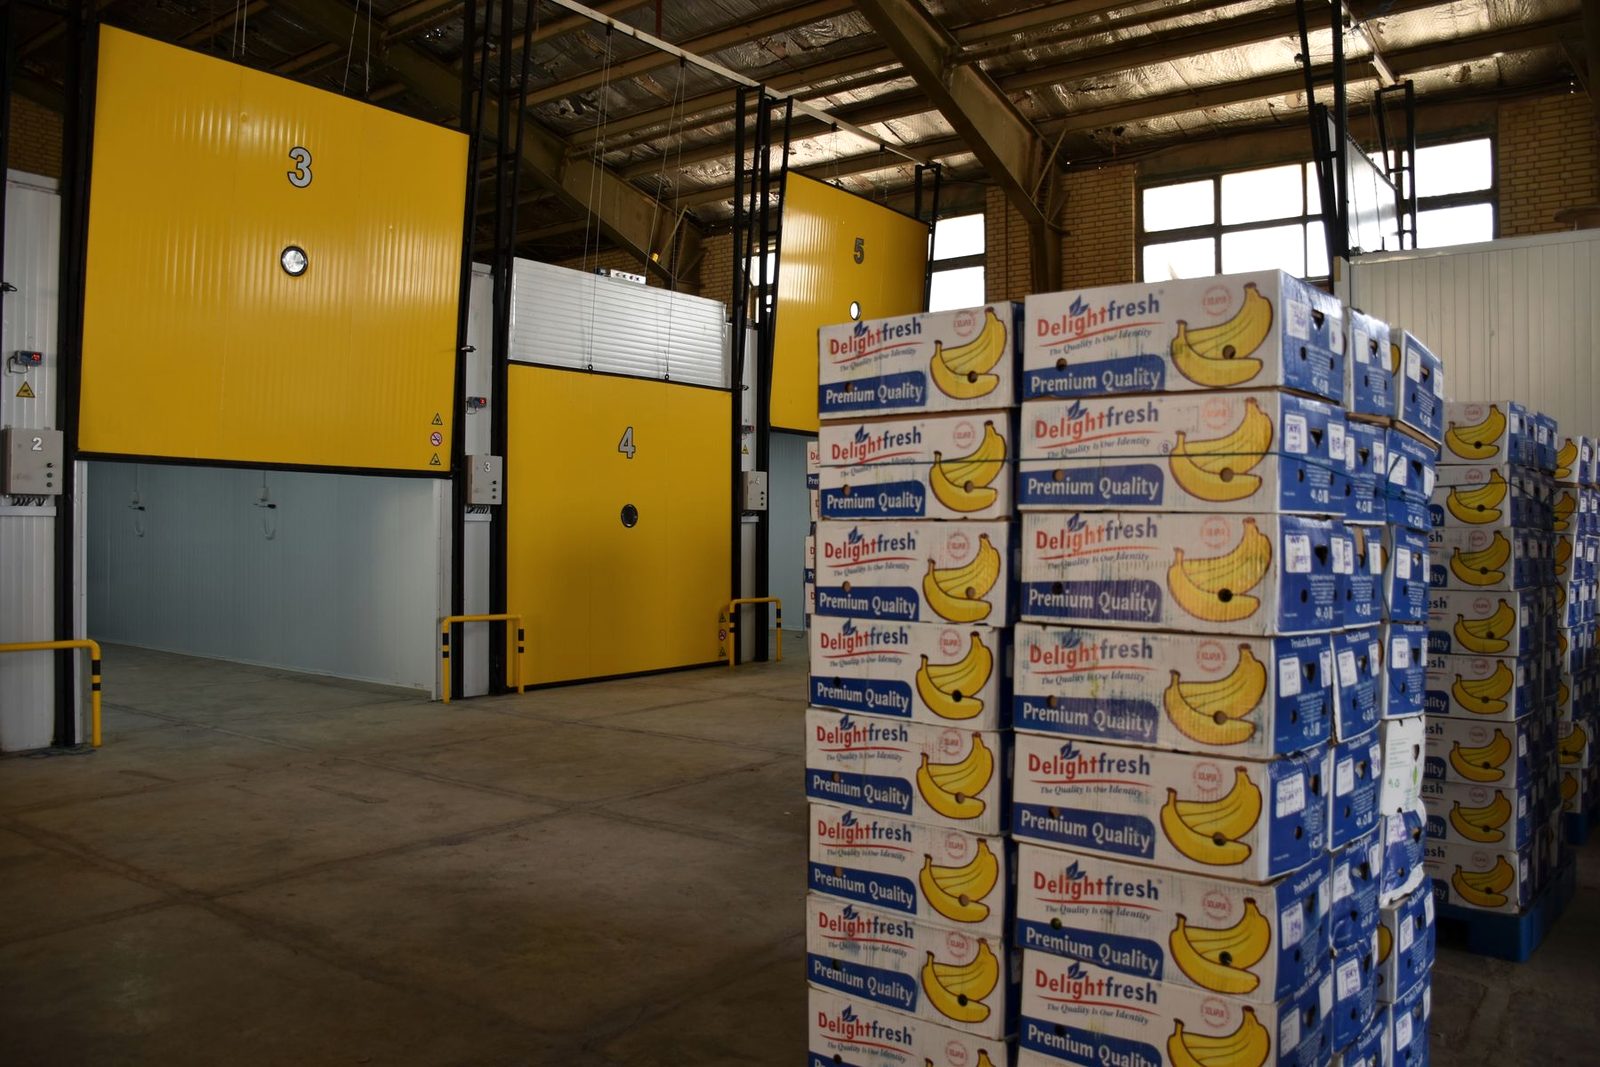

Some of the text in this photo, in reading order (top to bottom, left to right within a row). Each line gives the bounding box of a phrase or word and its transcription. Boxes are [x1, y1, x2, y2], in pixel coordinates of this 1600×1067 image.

[287, 146, 313, 188] 3
[853, 237, 865, 264] 5
[1037, 293, 1159, 337] Delightfresh
[830, 317, 921, 355] Delightfresh
[826, 383, 922, 404] Premium Quality
[1031, 368, 1160, 393] Premium Quality
[1035, 402, 1158, 440] Delightfresh
[32, 438, 42, 450] 2
[618, 426, 636, 459] 4
[832, 426, 921, 463] Delightfresh
[484, 462, 491, 472] 3
[827, 493, 875, 509] Premium
[879, 492, 922, 512] Quality
[1028, 476, 1159, 500] Premium Quality
[825, 532, 915, 561] Delightfresh
[1036, 517, 1157, 551] Delightfresh
[820, 593, 868, 610] Premium
[872, 596, 915, 618] Quality
[1029, 589, 1157, 616] Premium Quality
[821, 627, 908, 653] Delightfresh
[1030, 637, 1153, 669] Delightfresh
[1428, 638, 1449, 649] ality
[818, 683, 908, 712] Premium Quality
[1425, 697, 1447, 711] ality
[1023, 702, 1153, 737] Premium Quality
[817, 723, 908, 747] Delightfresh
[1029, 753, 1150, 780] Delightfresh
[814, 775, 909, 809] Premium Quality
[818, 821, 911, 843] Delightfresh
[1021, 810, 1150, 853] Premium Quality
[815, 868, 912, 909] Premium Quality
[1034, 871, 1158, 900] Delightfresh
[819, 912, 913, 939] Delightfresh
[1026, 927, 1158, 976] Premium Quality
[815, 961, 912, 1006] Premium Quality
[1036, 969, 1157, 1004] Delightfresh
[818, 1012, 912, 1045] Delightfresh
[1028, 1024, 1093, 1058] Premium
